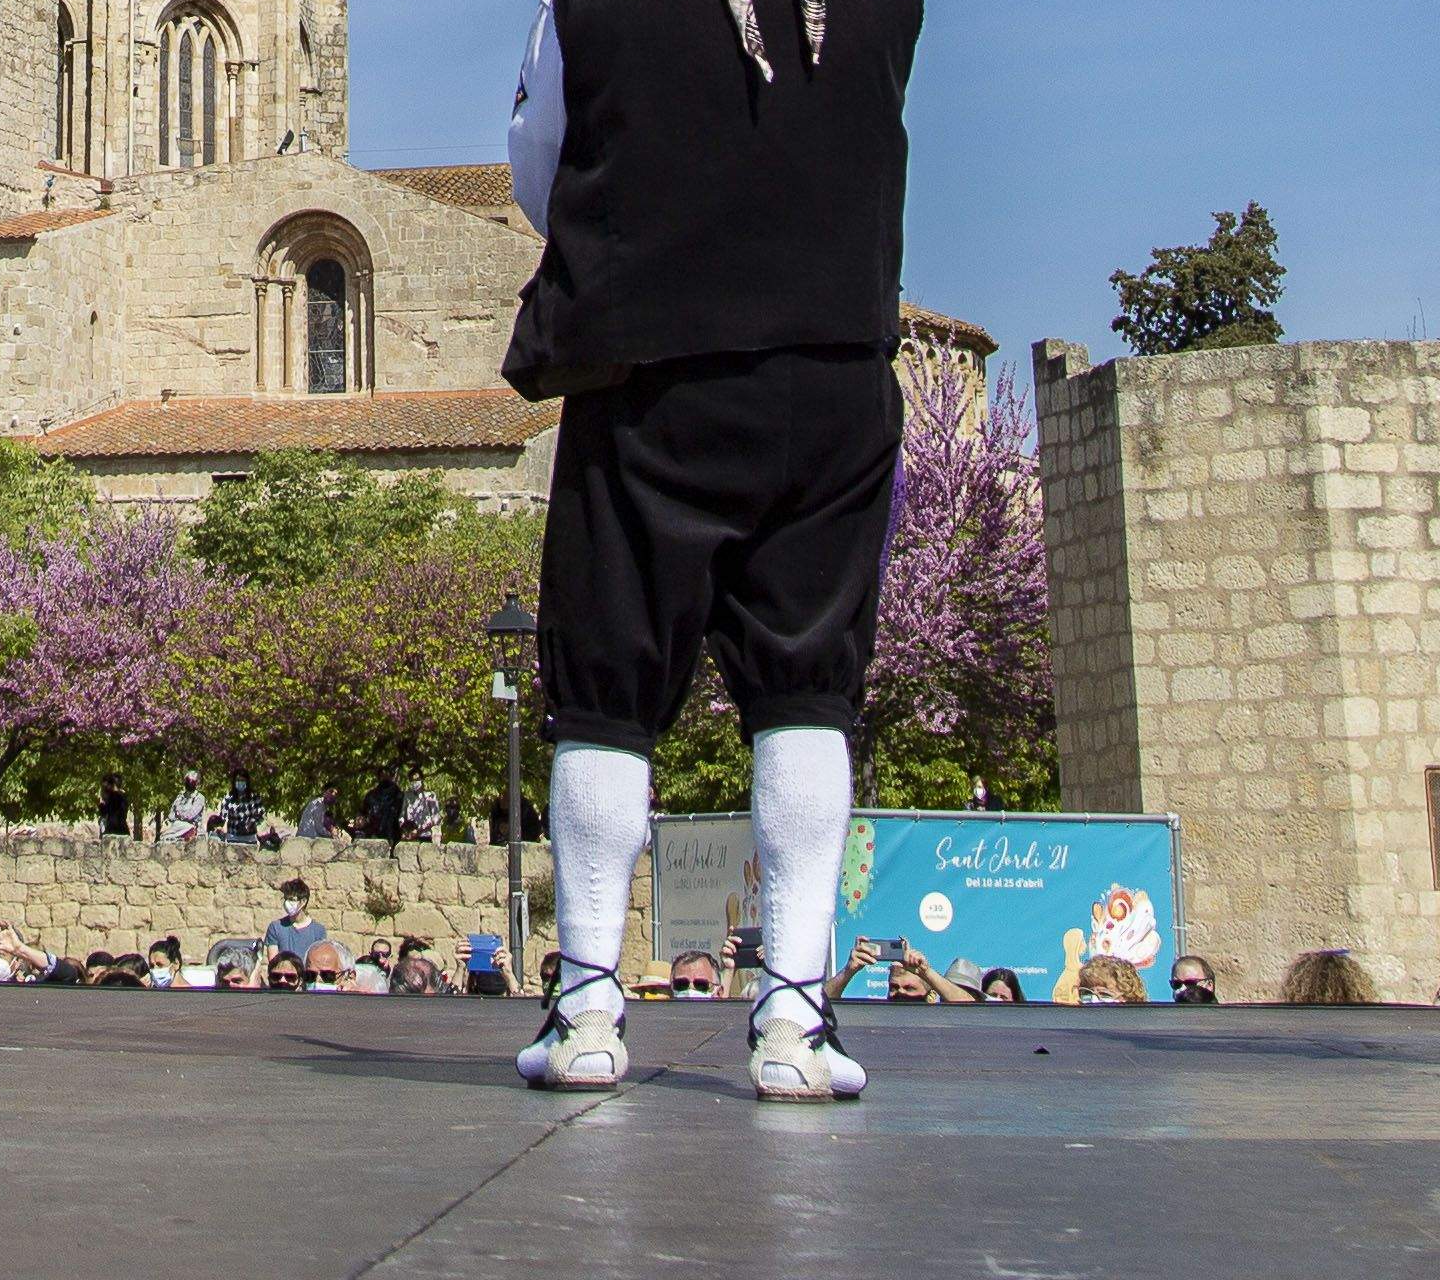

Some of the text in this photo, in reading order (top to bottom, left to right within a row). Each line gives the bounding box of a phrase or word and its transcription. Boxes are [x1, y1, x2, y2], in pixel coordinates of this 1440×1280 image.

[936, 836, 986, 870] Sant
[989, 836, 1043, 873] Jordi
[965, 877, 1044, 888] Del 10 al 25 d'abril
